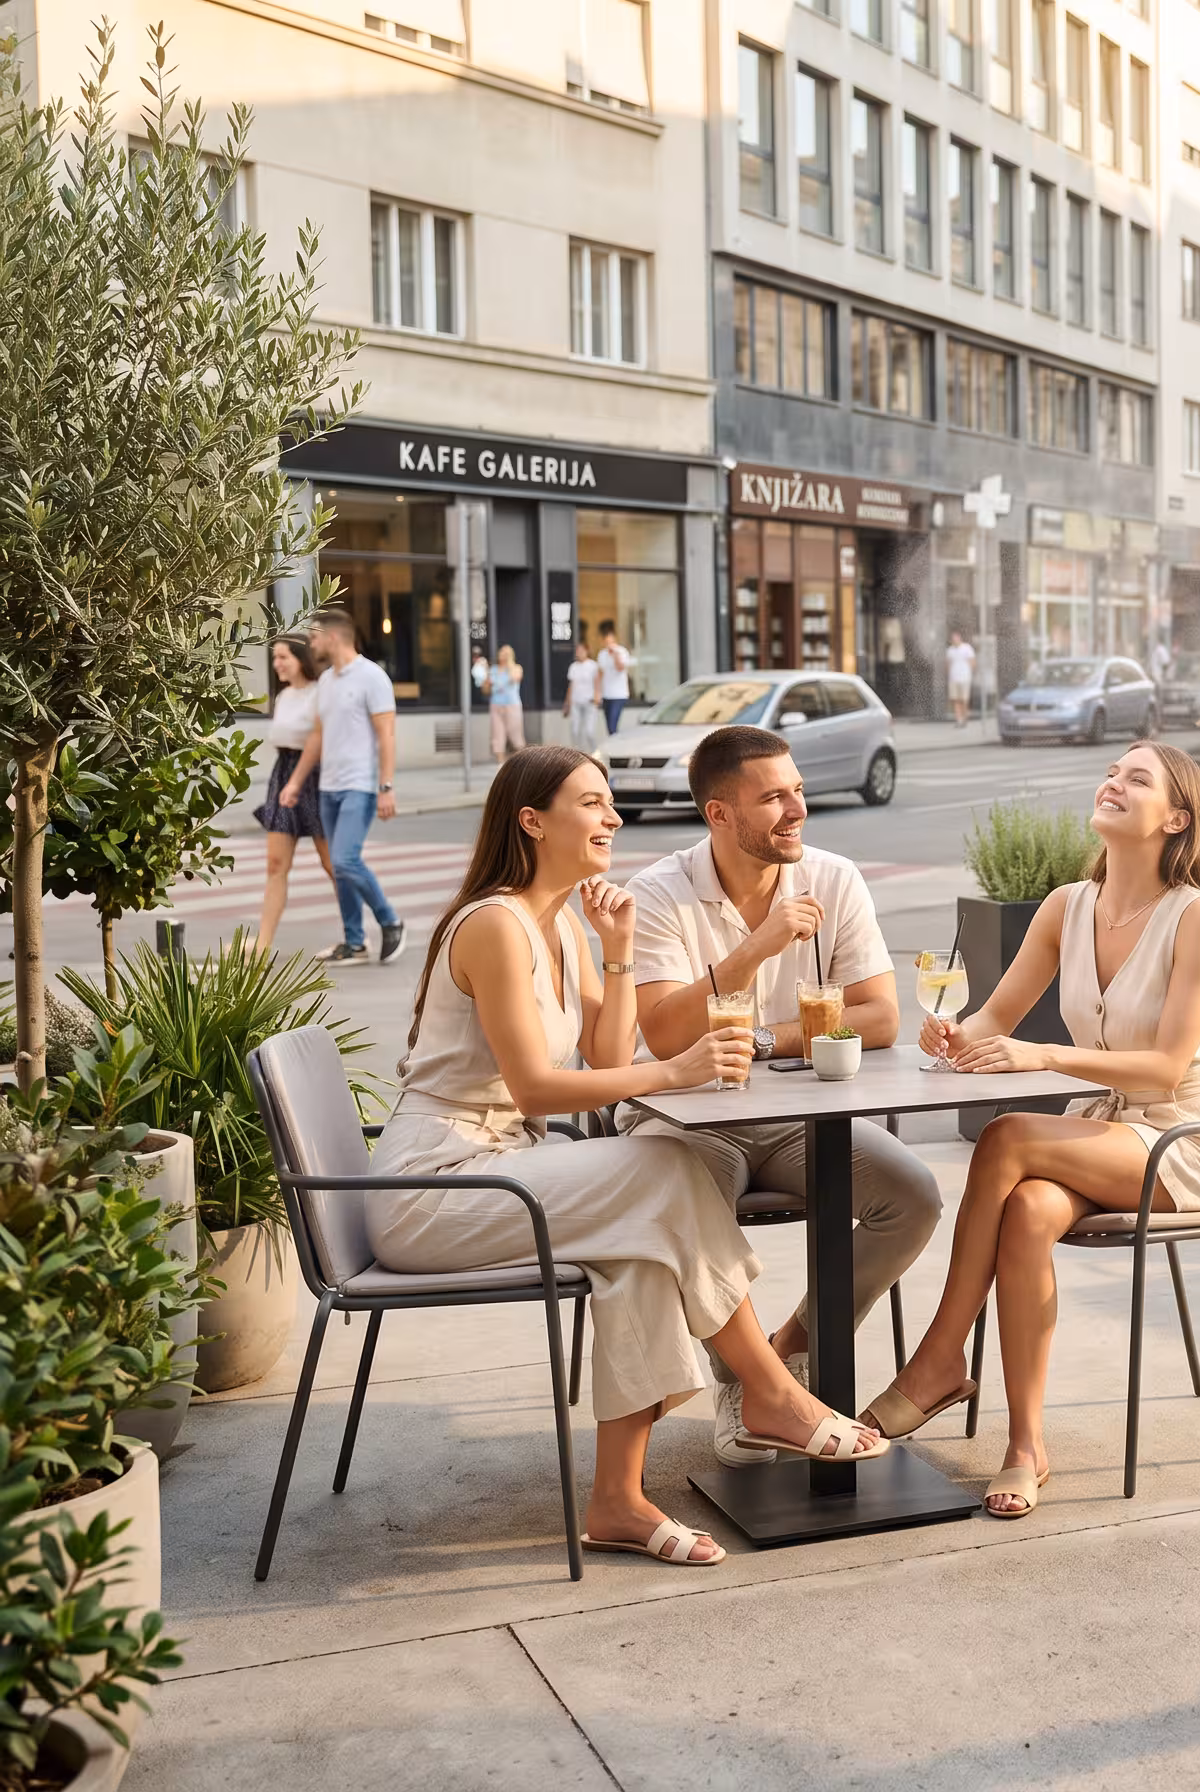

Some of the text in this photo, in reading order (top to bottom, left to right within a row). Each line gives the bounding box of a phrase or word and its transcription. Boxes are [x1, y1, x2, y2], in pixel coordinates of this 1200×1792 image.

[399, 441, 596, 487] KAFE GALERIJA
[741, 473, 845, 514] KNJIŽARA
